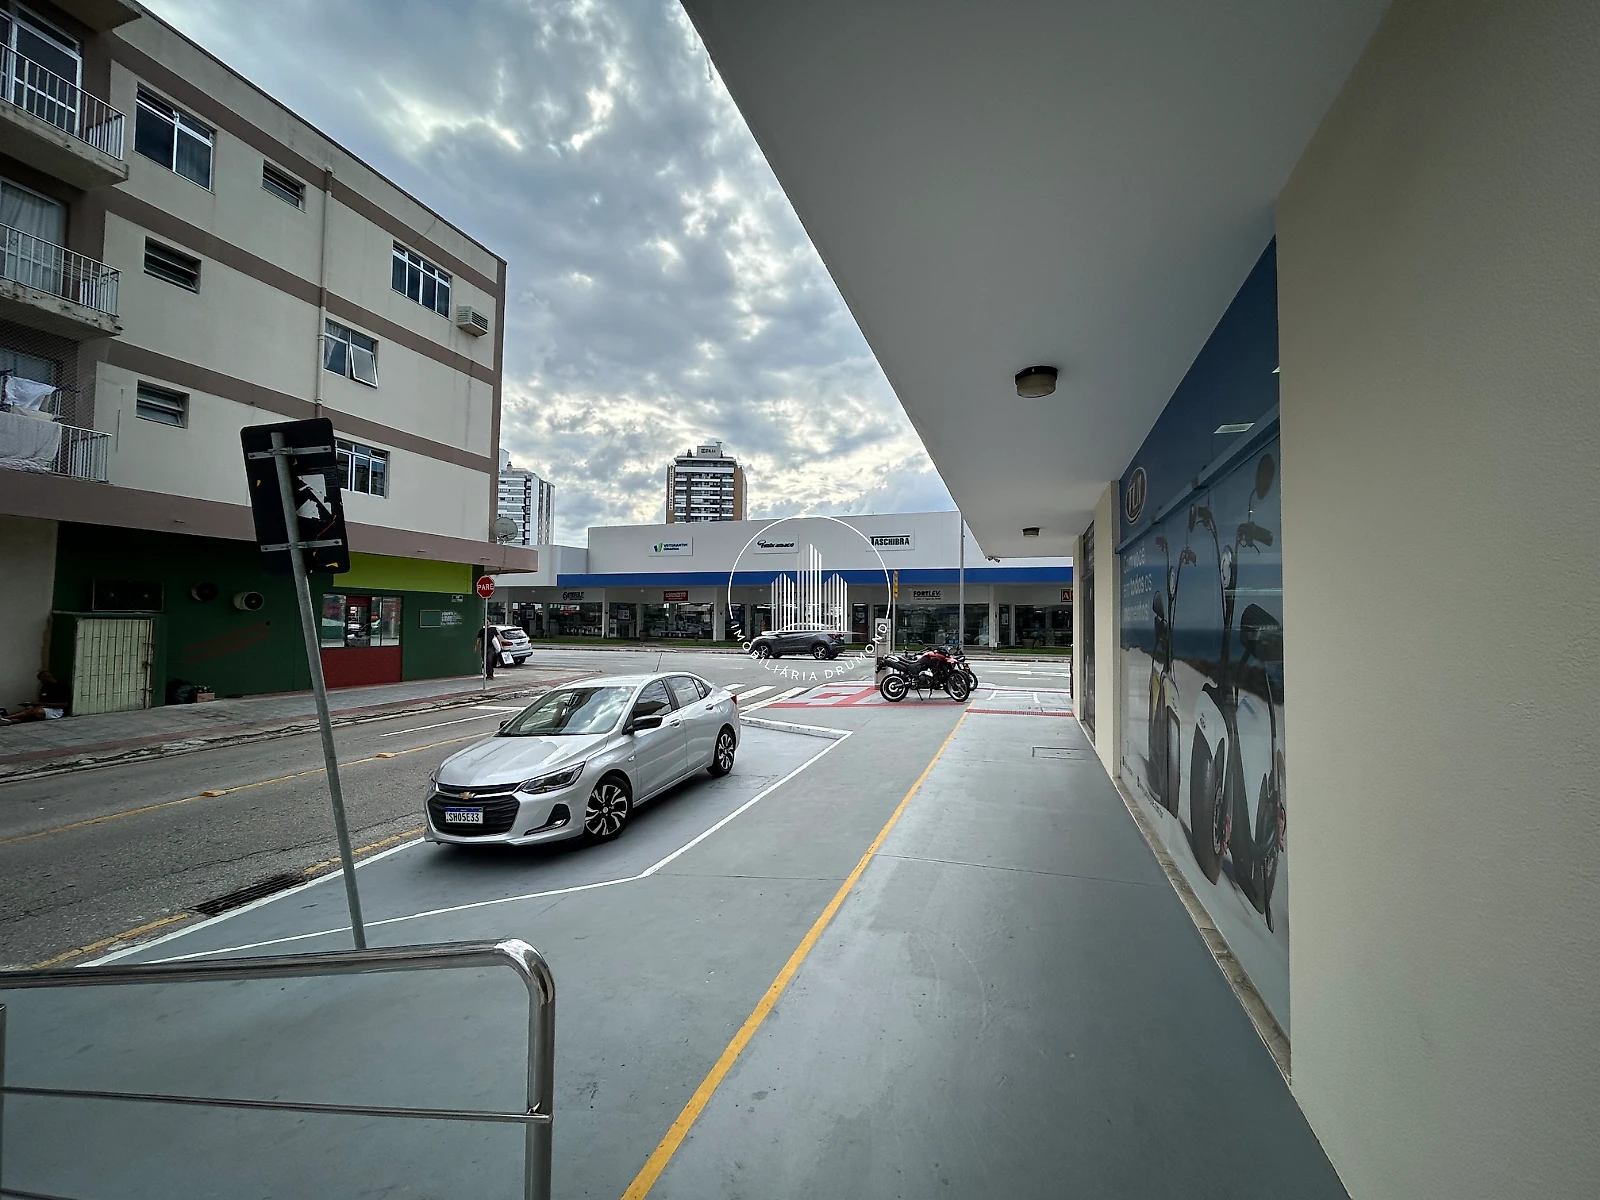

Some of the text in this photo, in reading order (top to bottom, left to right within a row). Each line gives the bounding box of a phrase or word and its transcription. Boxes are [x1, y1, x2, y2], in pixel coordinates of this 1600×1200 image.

[870, 535, 910, 546] TASCHIBRA
[477, 583, 494, 591] PARE
[1130, 573, 1144, 597] todos
[1144, 572, 1153, 592] os
